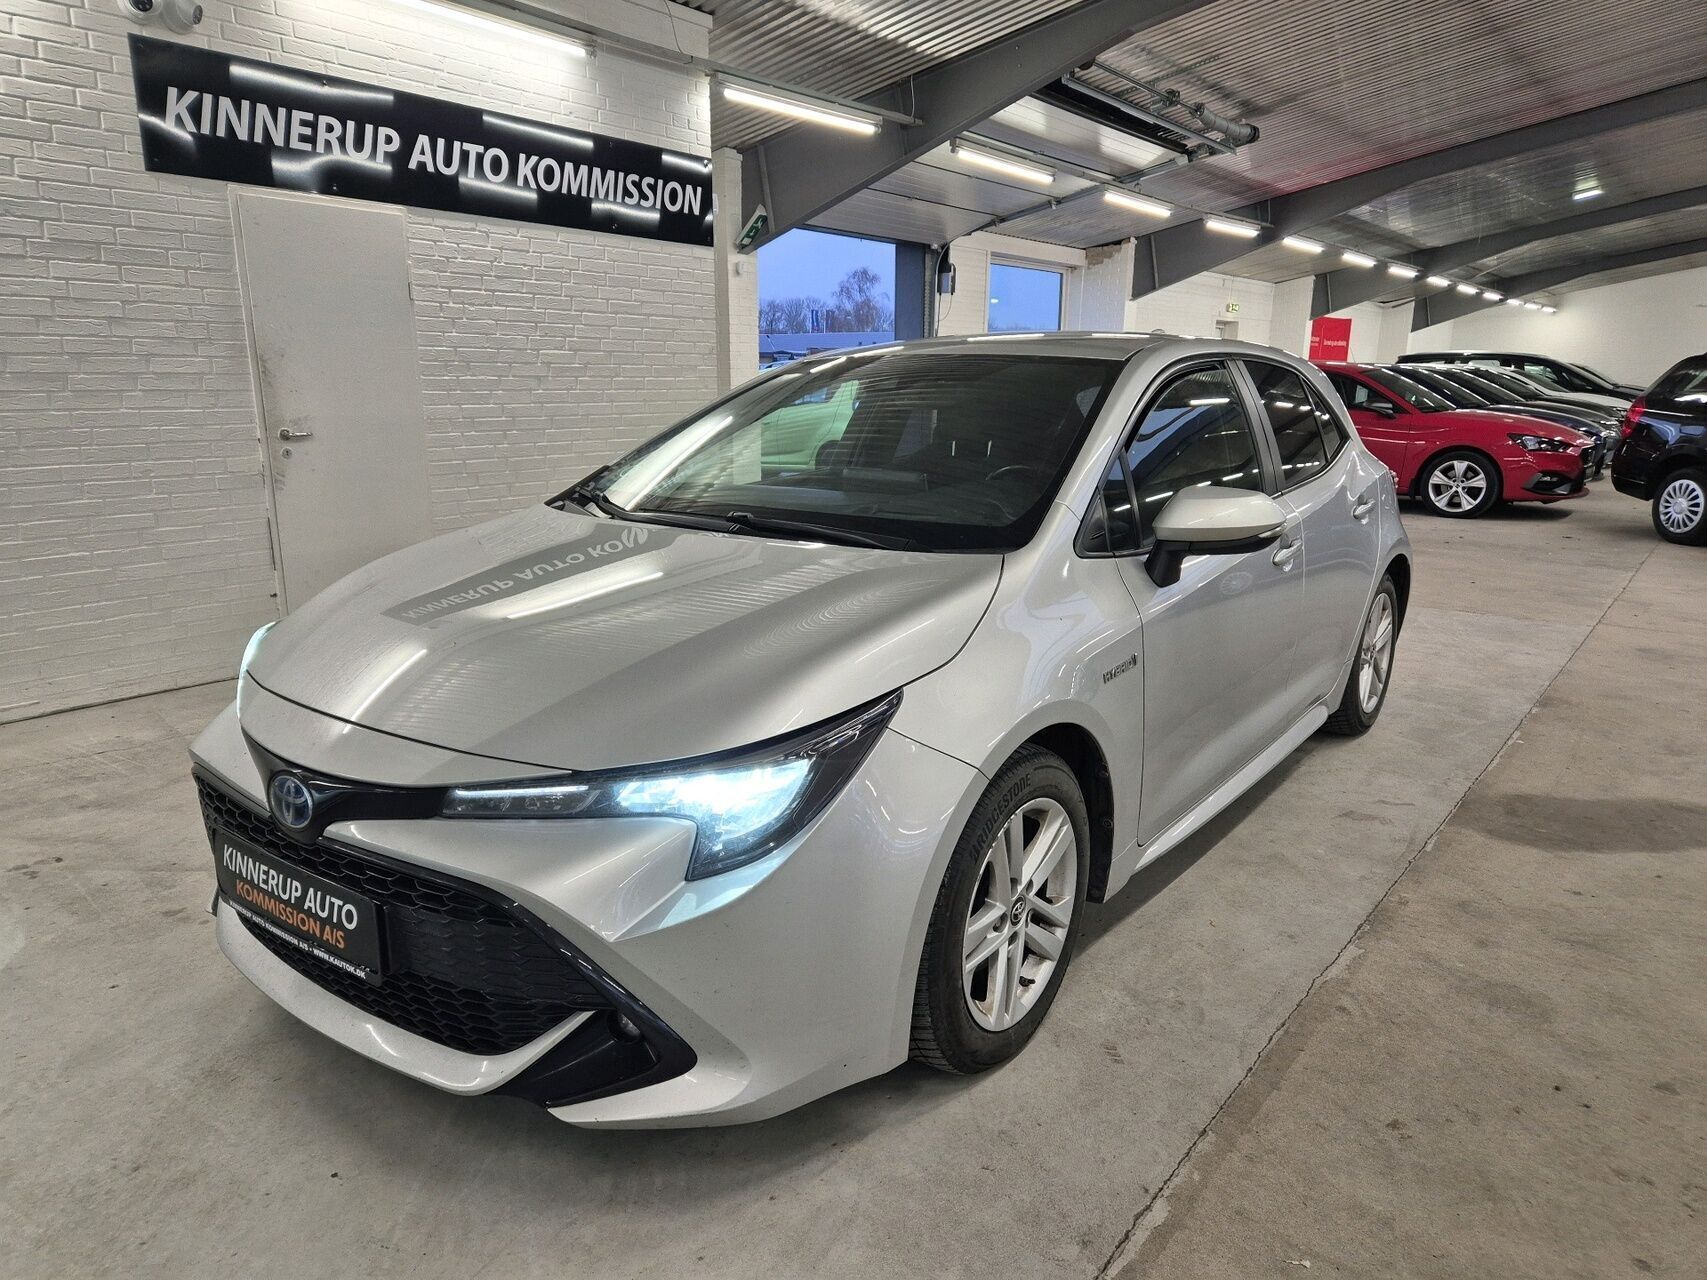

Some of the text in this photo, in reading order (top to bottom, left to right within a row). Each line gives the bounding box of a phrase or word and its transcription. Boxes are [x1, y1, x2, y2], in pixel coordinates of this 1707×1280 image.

[165, 86, 702, 216] KINNERUP AUTO KOMMISSION
[223, 844, 358, 930] KINNERUP AUTO
[236, 879, 321, 938] KOMMISSION
